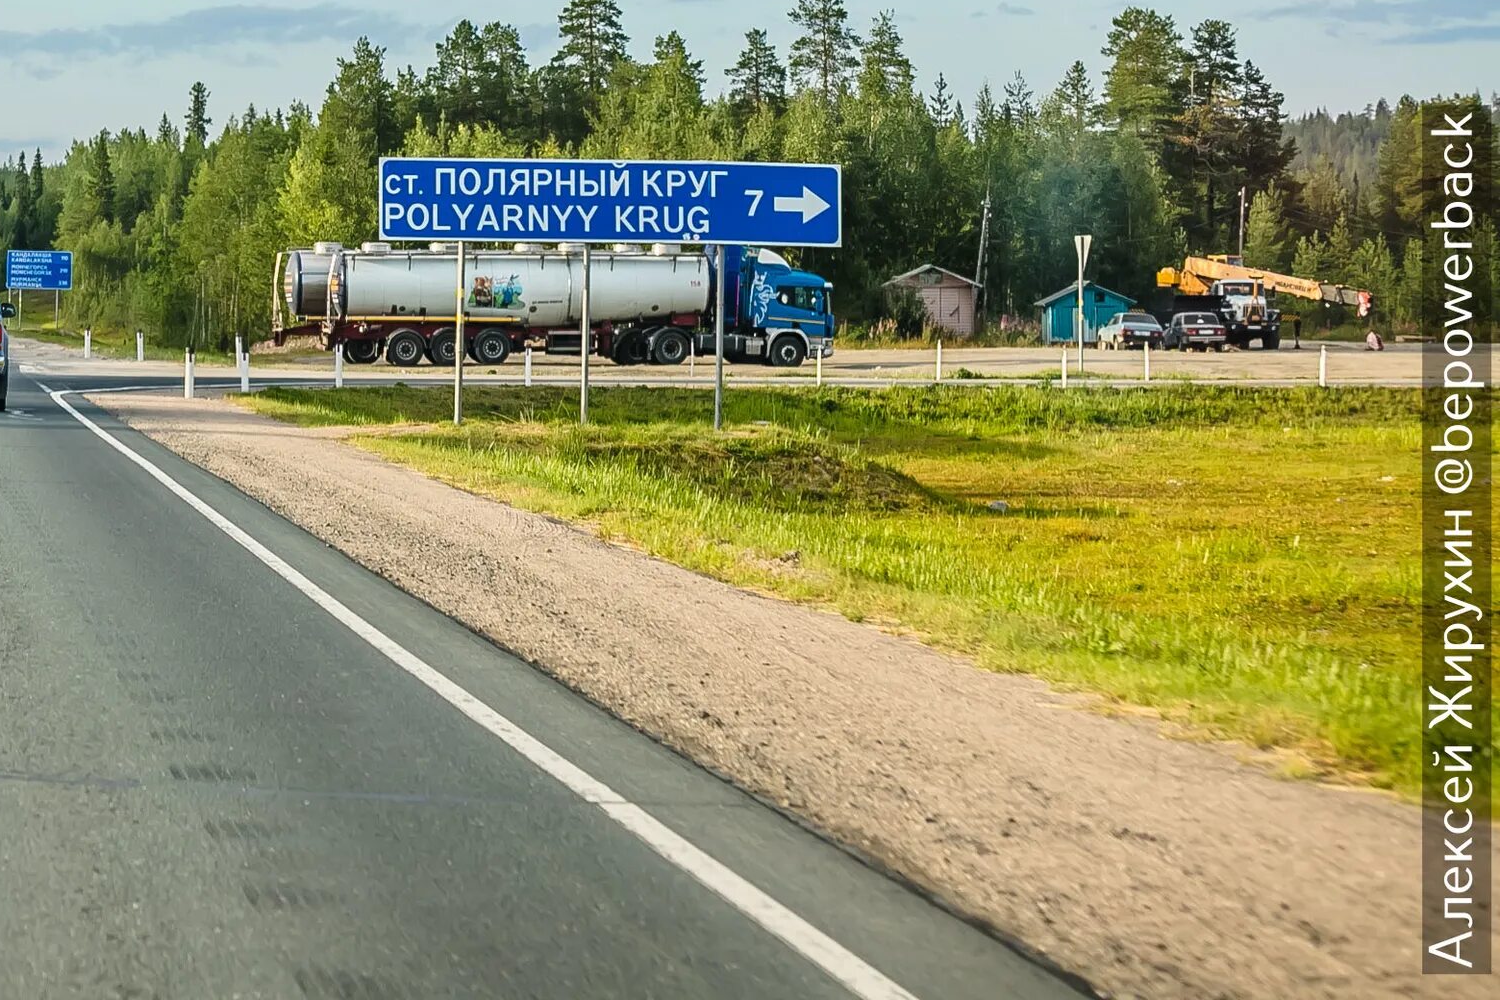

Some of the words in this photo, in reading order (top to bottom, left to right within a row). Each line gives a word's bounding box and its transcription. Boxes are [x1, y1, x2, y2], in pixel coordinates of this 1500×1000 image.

[385, 174, 424, 196] ст.
[435, 163, 630, 198] ПОЛЯРНЫЙ
[642, 169, 729, 198] КРУГ
[385, 202, 598, 233] POLYARNYY
[615, 205, 710, 234] KRUG
[744, 189, 764, 217] 7
